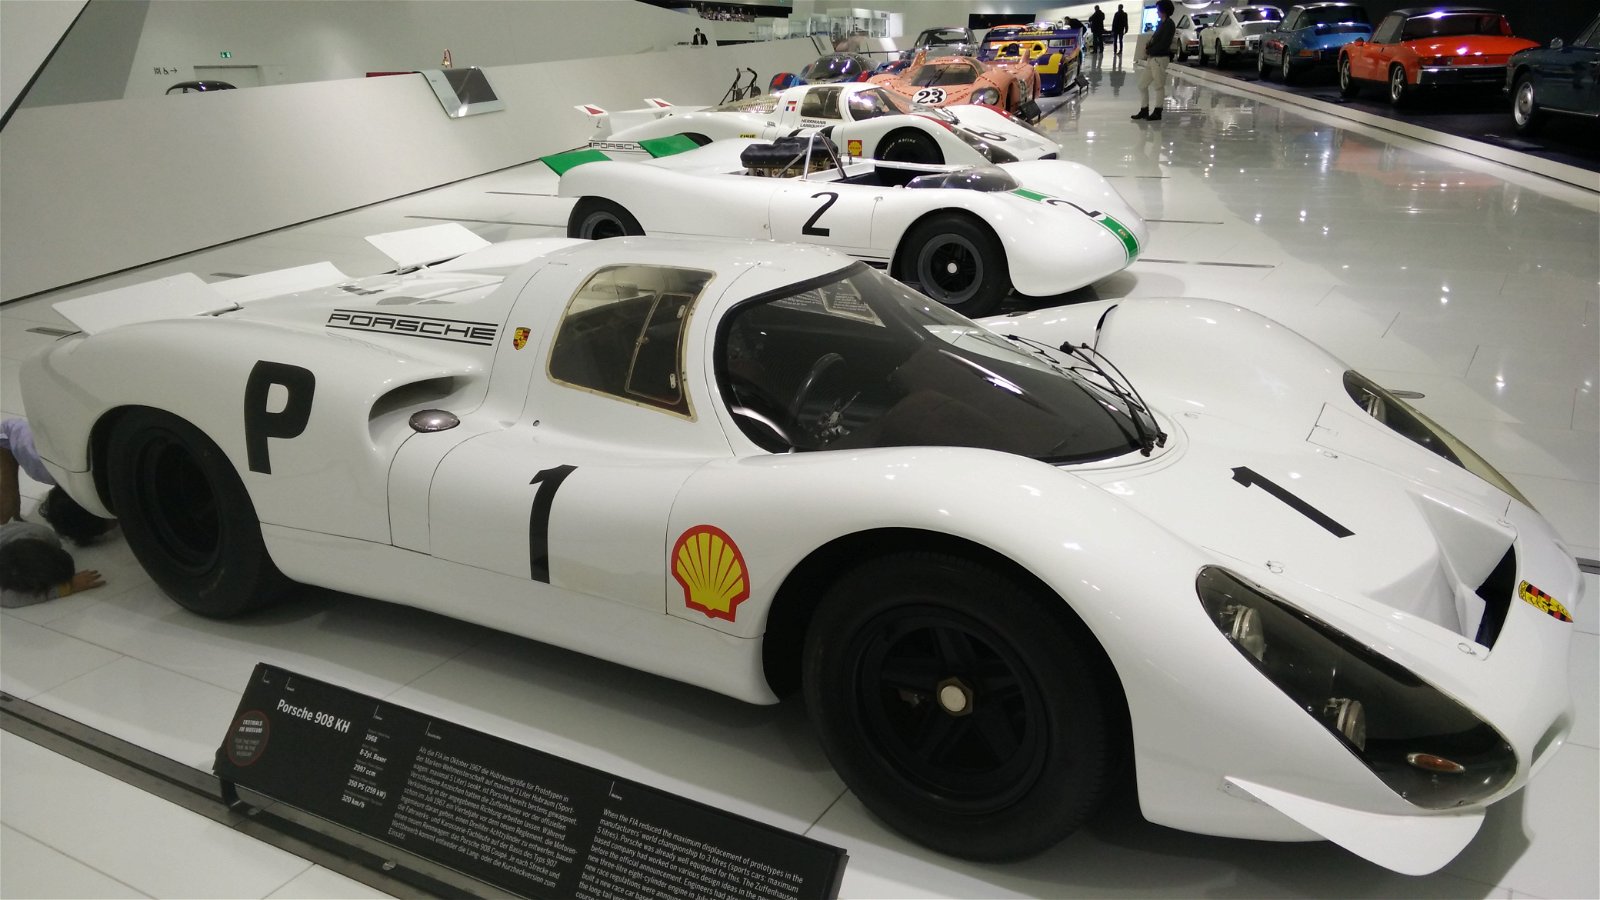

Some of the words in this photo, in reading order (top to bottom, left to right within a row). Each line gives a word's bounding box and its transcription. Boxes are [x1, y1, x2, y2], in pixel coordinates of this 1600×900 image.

[918, 90, 944, 104] 23
[802, 192, 840, 236] 2
[1046, 199, 1102, 217] 2
[328, 313, 498, 340] PORSCHE
[244, 360, 316, 474] P
[1231, 466, 1356, 538] 1
[529, 464, 578, 584] 1
[276, 698, 313, 720] Porsche
[314, 711, 333, 728] 908
[334, 720, 351, 734] KH
[365, 734, 378, 742] 1968
[351, 797, 366, 808] km/h
[489, 788, 509, 801] Porsche
[534, 785, 562, 799] Prototypen
[603, 809, 618, 819] When
[628, 817, 638, 826] FIA
[638, 822, 662, 834] reduced
[662, 829, 672, 838] the
[672, 834, 701, 848] maximum
[702, 843, 742, 862] displacement
[749, 861, 783, 876] prototypes
[792, 874, 802, 883] the
[620, 834, 642, 848] Porsche
[654, 848, 676, 861] already
[689, 861, 717, 874] equipped
[718, 869, 727, 877] for
[742, 877, 754, 888] The
[641, 834, 658, 843] world
[658, 839, 698, 858] championship
[711, 856, 727, 867] litres
[727, 862, 750, 876] (sports
[767, 877, 798, 892] maximum
[609, 851, 618, 860] the
[683, 878, 712, 894] Engineers
[714, 889, 726, 899] had
[611, 843, 636, 857] company
[636, 850, 648, 860] had
[648, 856, 669, 868] worked
[678, 867, 699, 879] various
[700, 874, 720, 886] design
[721, 882, 737, 892] ideas
[745, 890, 756, 899] the
[668, 884, 688, 896] engine
